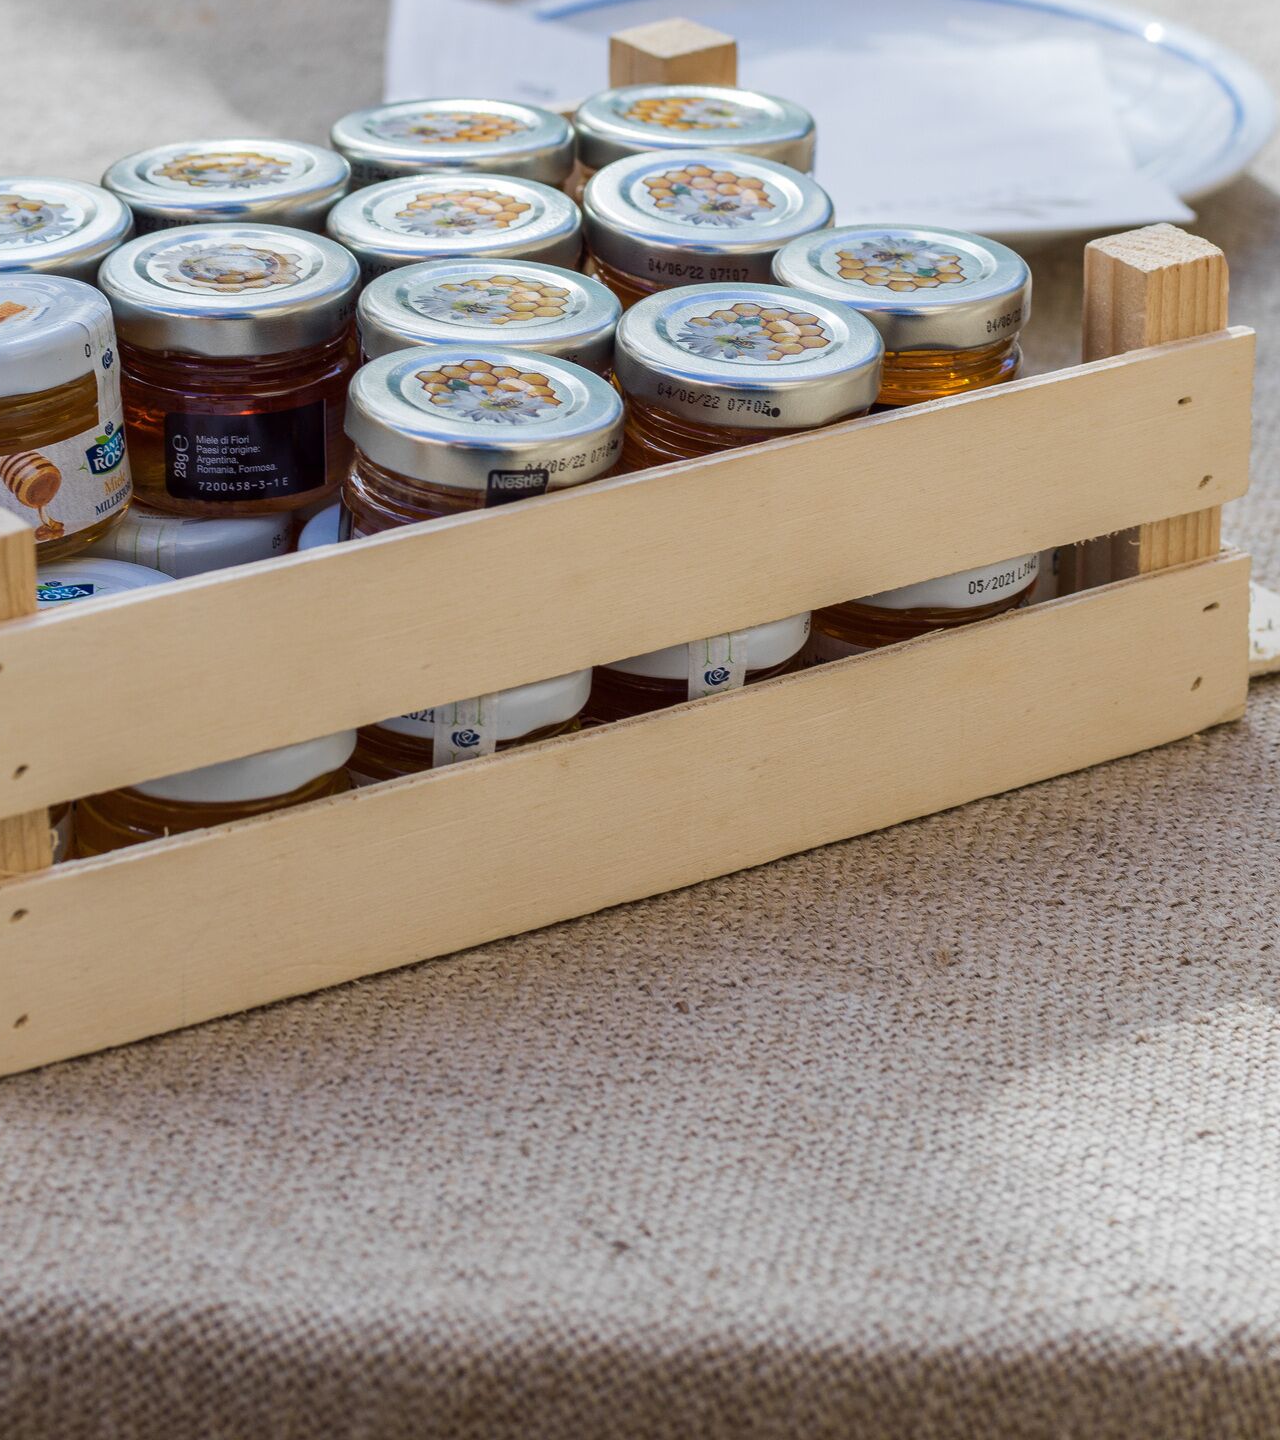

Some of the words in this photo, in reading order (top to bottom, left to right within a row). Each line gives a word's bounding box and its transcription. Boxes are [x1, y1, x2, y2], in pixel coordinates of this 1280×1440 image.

[657, 382, 721, 409] 04/06/22
[96, 432, 123, 457] SANTA
[196, 435, 219, 445] Miele
[221, 435, 229, 445] di
[231, 435, 250, 444] Fiori
[196, 445, 220, 455] Paesi
[968, 570, 1015, 595] 05/2021
[37, 586, 81, 595] ANTA
[401, 709, 436, 723] 021
